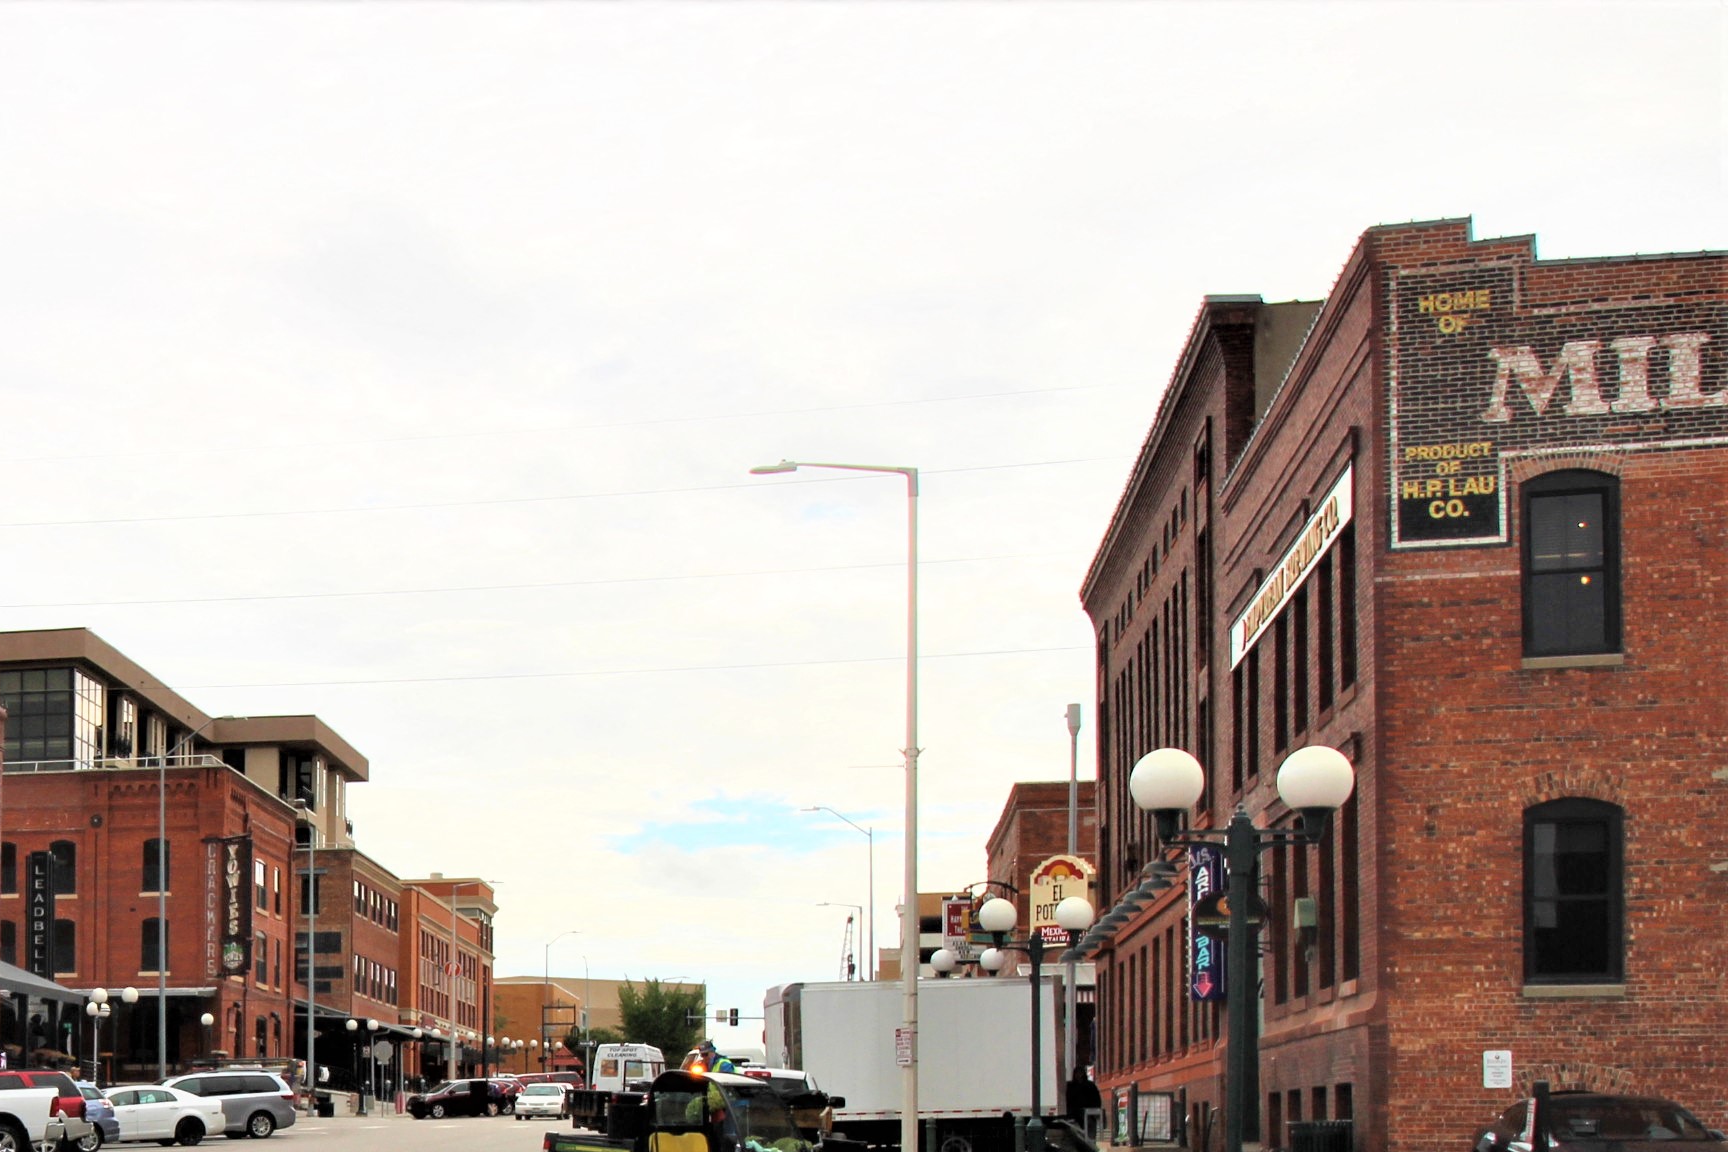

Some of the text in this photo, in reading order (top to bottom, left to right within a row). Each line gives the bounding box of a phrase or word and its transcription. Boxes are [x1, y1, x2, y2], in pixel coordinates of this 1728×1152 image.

[1418, 289, 1490, 313] HOME
[1439, 315, 1471, 334] OF
[1405, 441, 1491, 461] PRODUCT
[1436, 460, 1462, 475] OF
[1403, 476, 1495, 499] H.P. LAU
[1428, 499, 1470, 518] CO.
[1053, 885, 1065, 902] EL
[34, 865, 44, 973] LEADBELL
